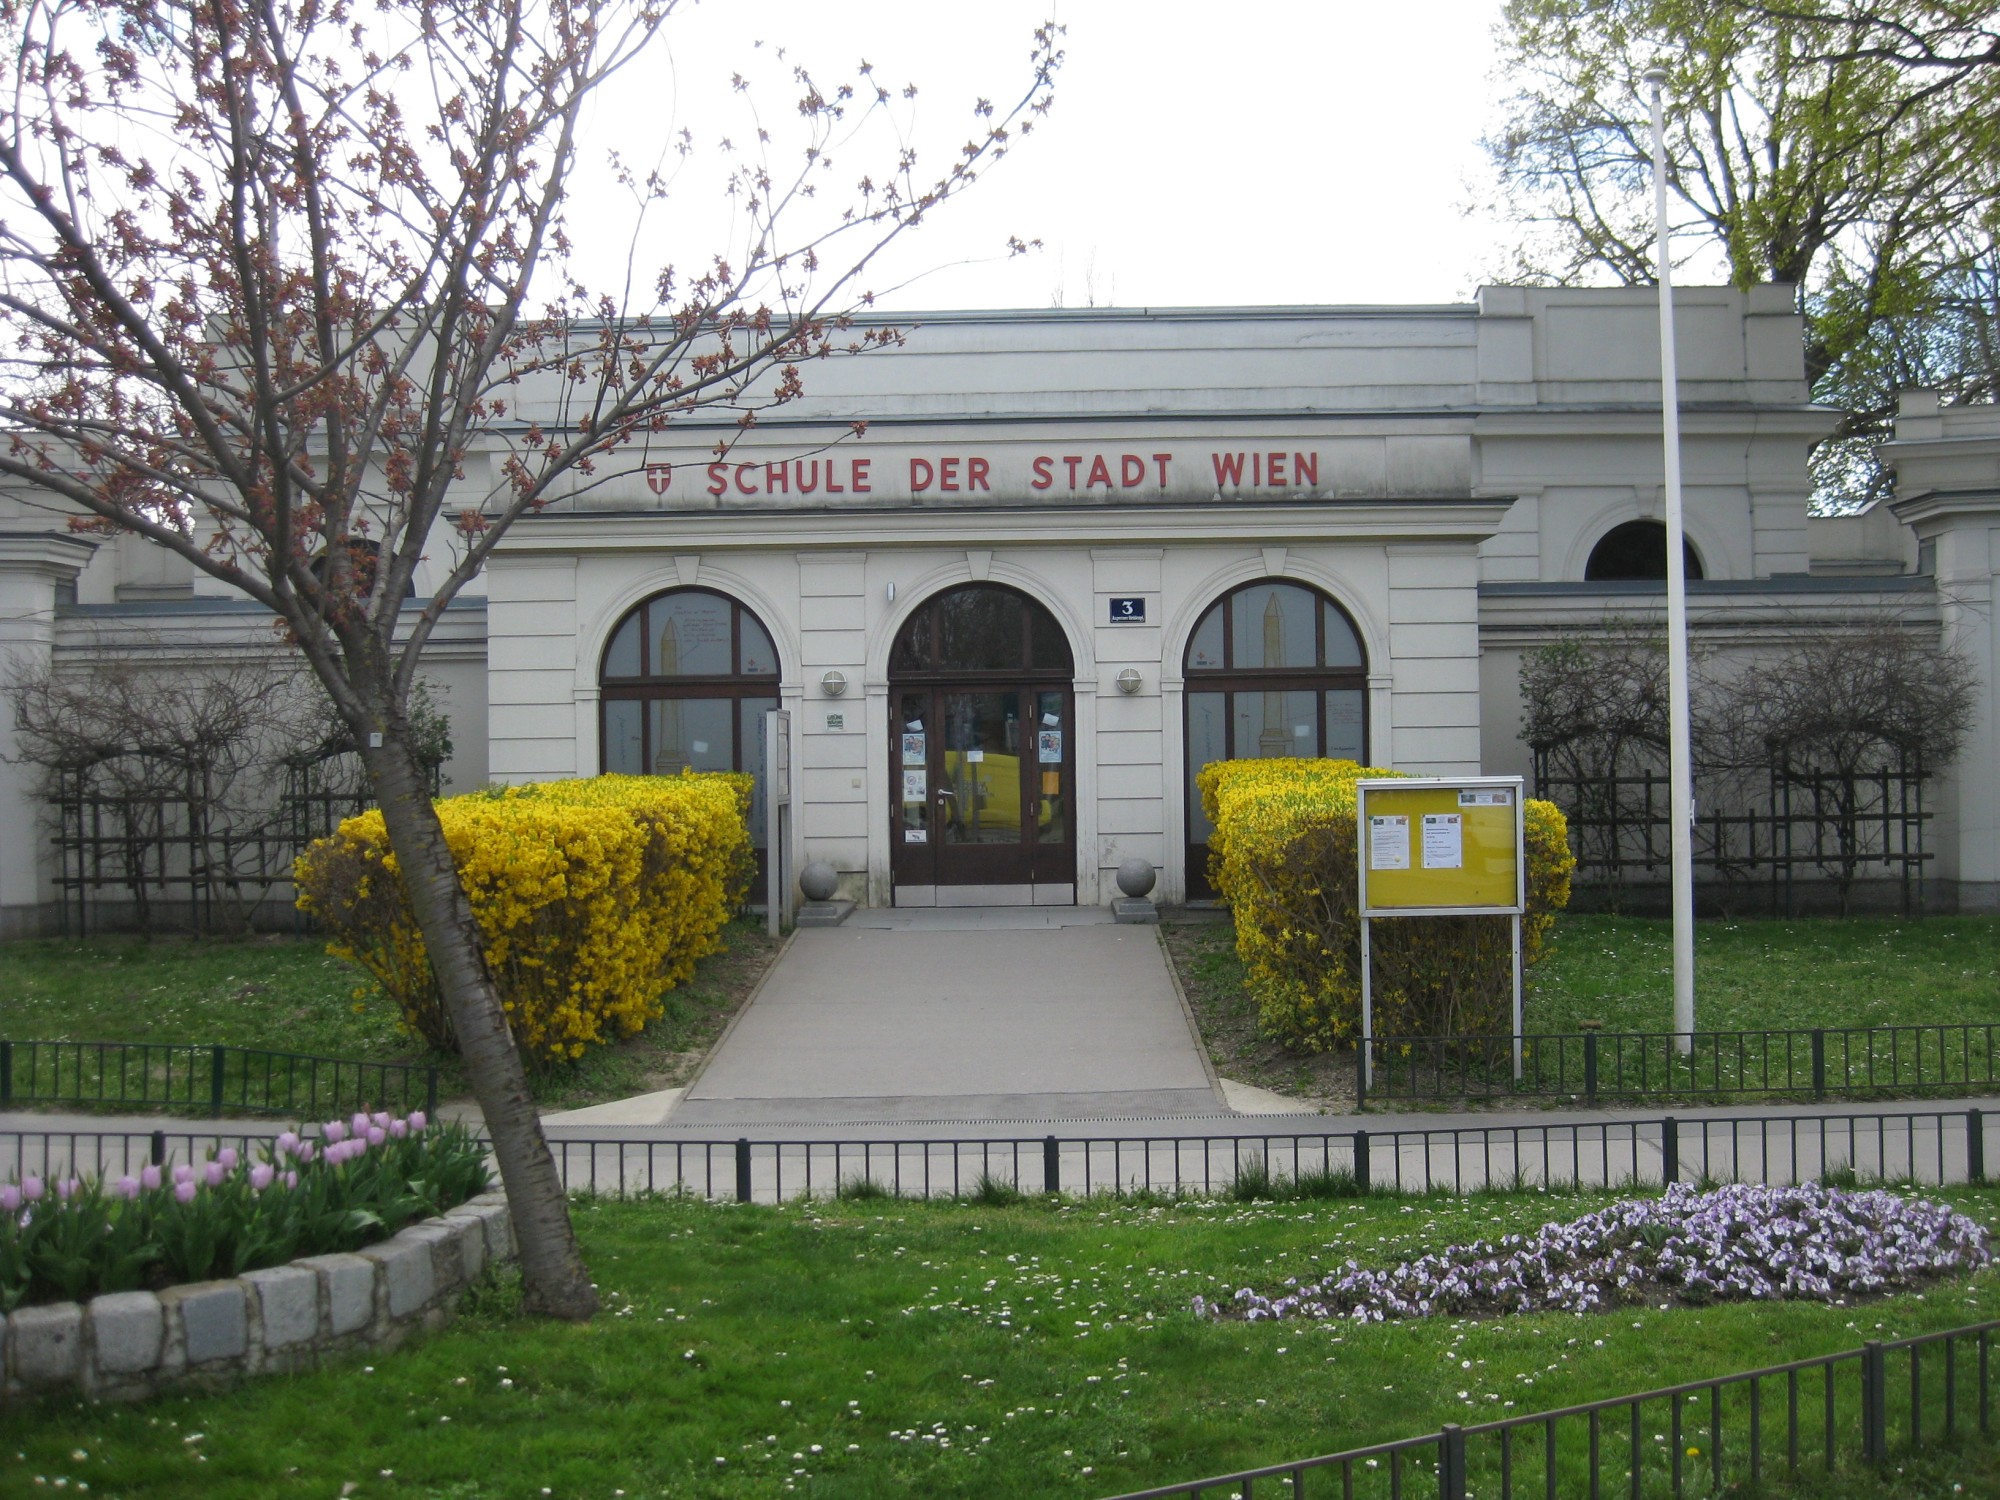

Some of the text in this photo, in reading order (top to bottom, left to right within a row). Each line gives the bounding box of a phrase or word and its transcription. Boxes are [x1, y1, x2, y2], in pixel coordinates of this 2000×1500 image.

[707, 451, 1319, 494] SCHULE DER STADT WIEN
[1121, 601, 1134, 615] 3
